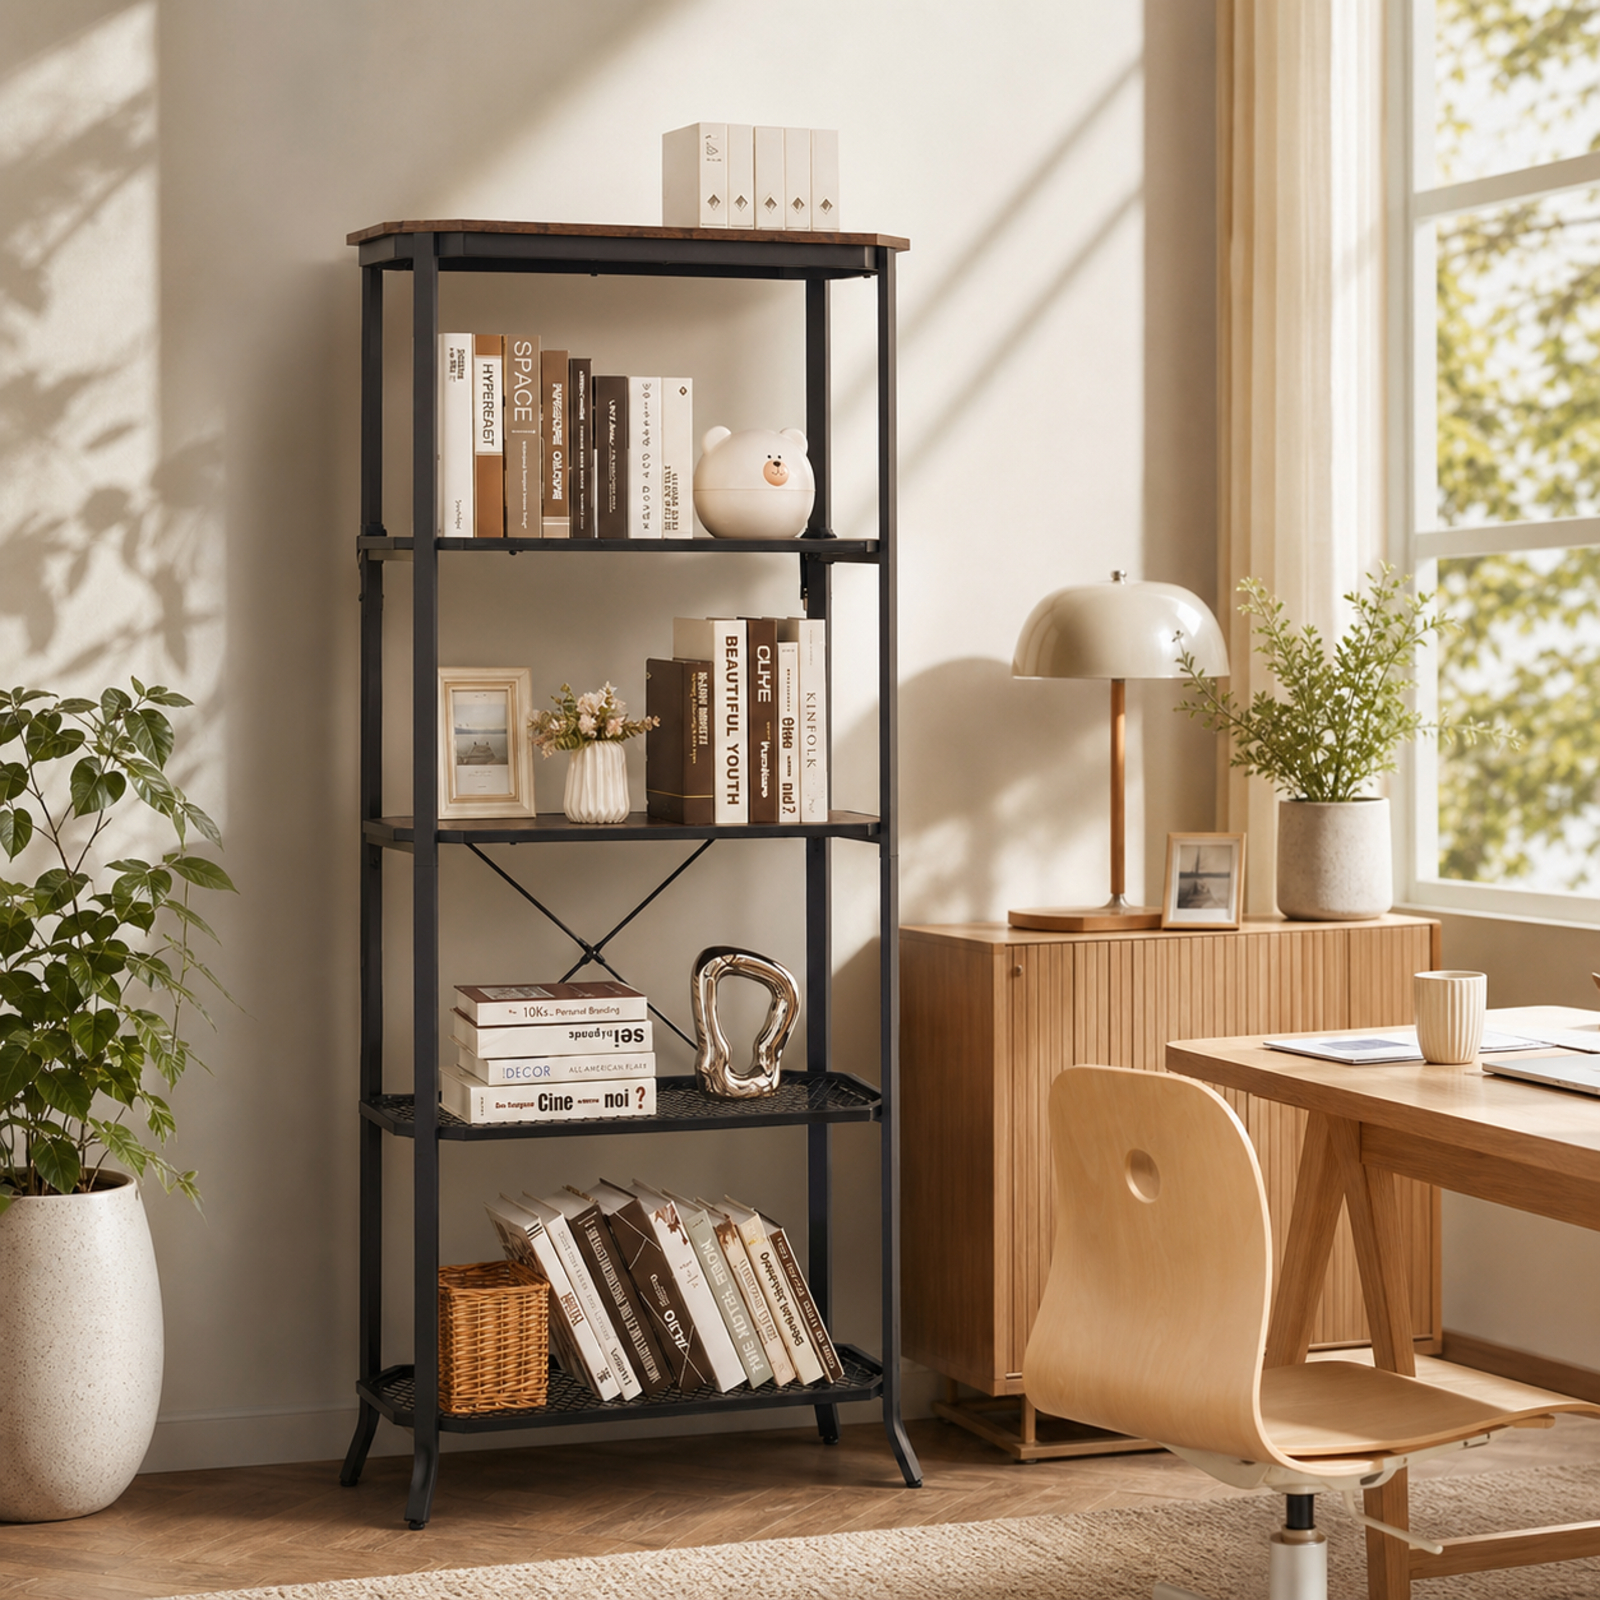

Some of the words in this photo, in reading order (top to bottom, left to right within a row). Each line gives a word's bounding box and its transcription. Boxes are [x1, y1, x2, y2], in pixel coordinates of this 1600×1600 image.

[513, 340, 533, 422] SPACE
[725, 635, 739, 737] BEAUTIFUL
[806, 692, 817, 768] KINFOLK
[726, 743, 740, 805] YOUTH
[537, 1092, 574, 1112] Cine
[604, 1088, 629, 1108] noi
